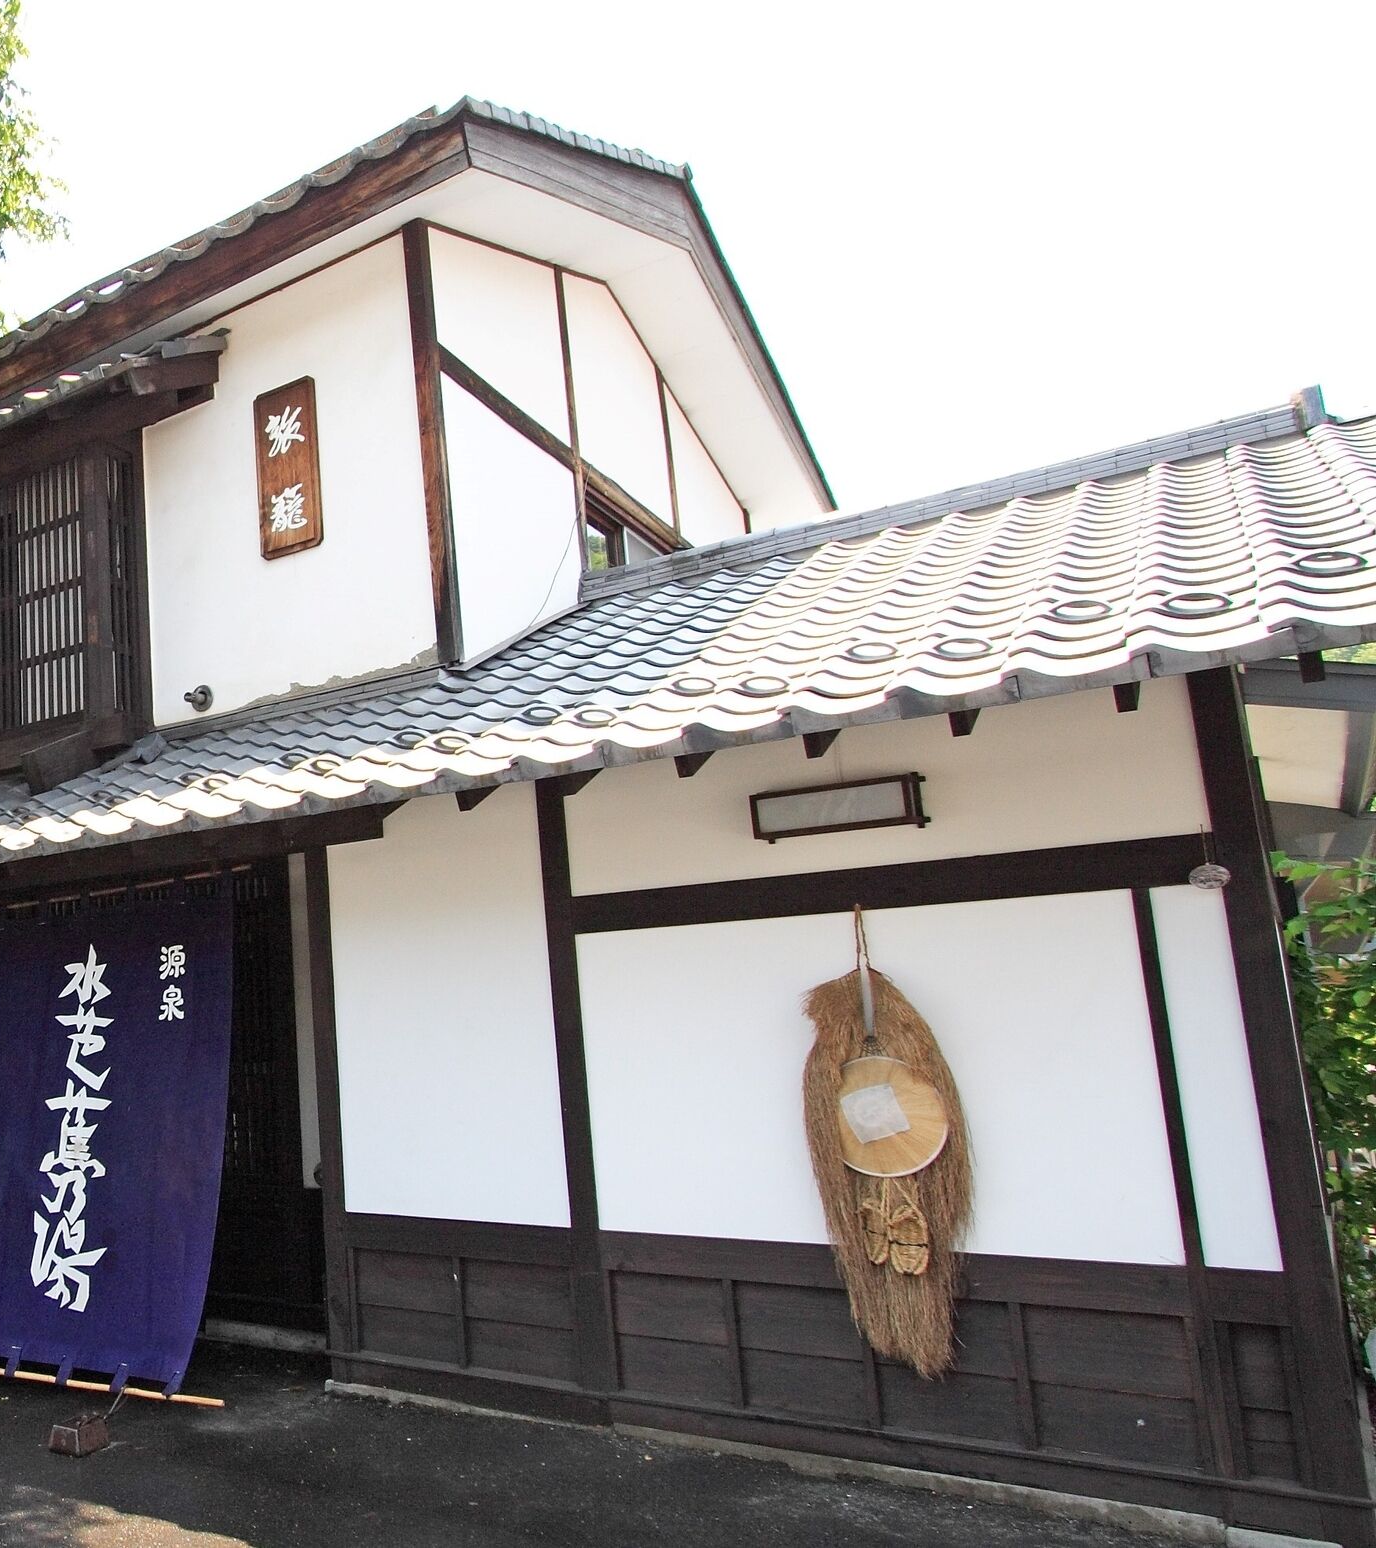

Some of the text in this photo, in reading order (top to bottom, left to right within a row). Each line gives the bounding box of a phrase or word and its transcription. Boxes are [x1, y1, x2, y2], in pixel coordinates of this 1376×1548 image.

[158, 944, 186, 1022] 源泉
[30, 943, 115, 1313] 水芭蕉乃湯
